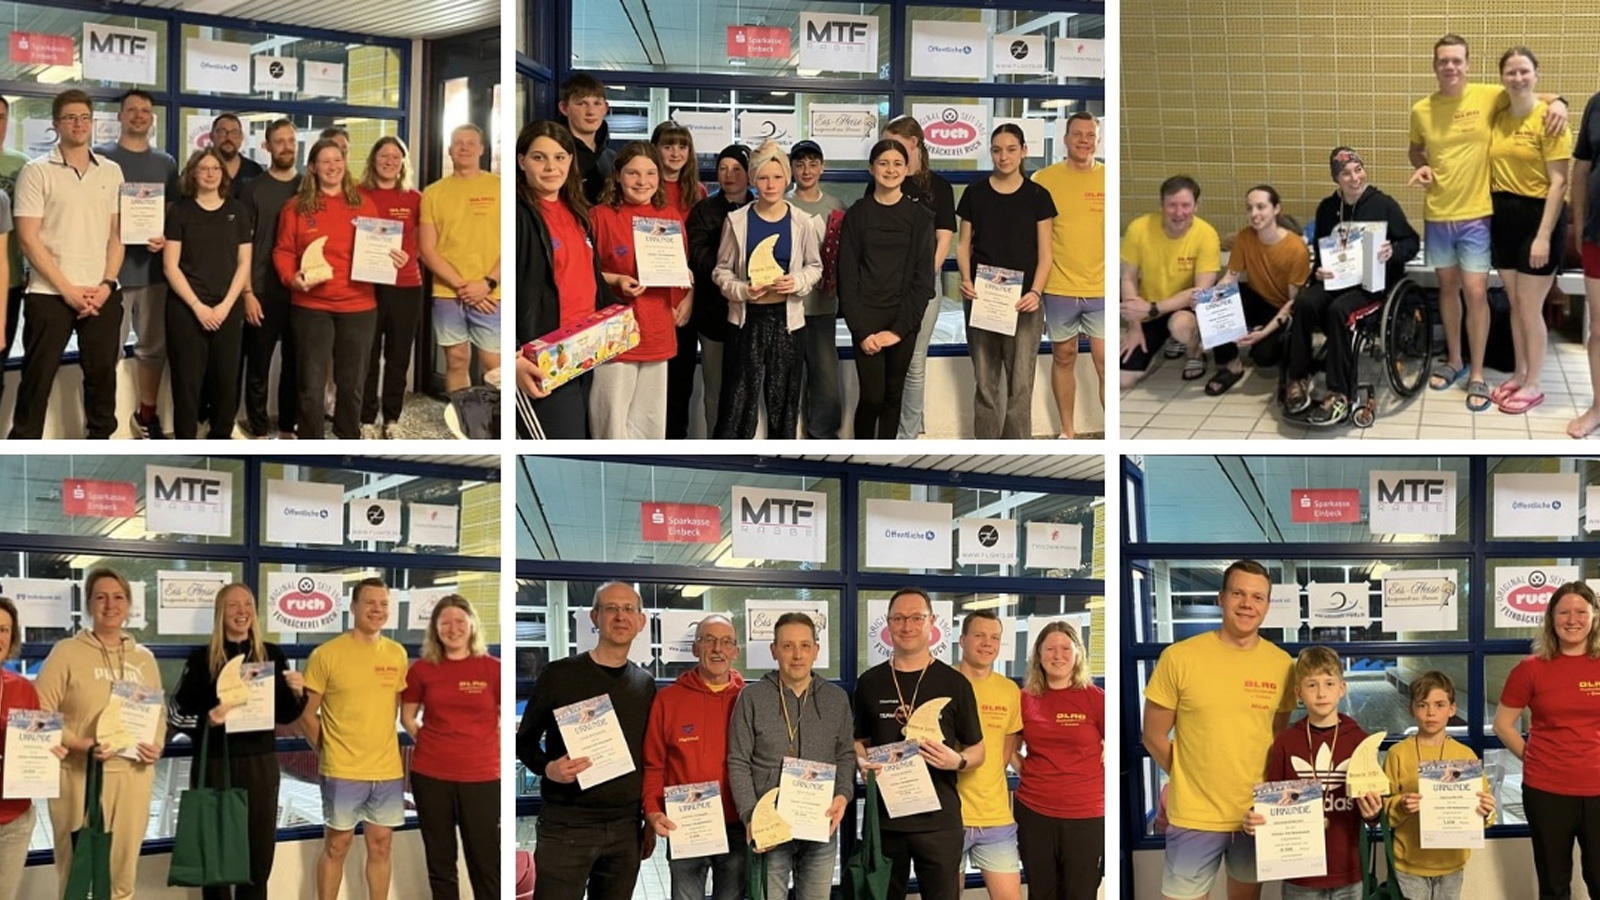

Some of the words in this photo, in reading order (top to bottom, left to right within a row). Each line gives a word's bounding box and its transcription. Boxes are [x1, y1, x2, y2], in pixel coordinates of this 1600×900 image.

[807, 20, 868, 42] MTF
[91, 31, 148, 55] MTF
[748, 36, 782, 45] Sparkasse
[748, 45, 774, 53] Einbeck
[931, 127, 970, 139] ruch
[155, 475, 220, 501] MTF
[1378, 479, 1444, 503] MTF
[1314, 500, 1351, 509] Sparkasse
[741, 496, 814, 525] MTF
[1314, 509, 1342, 518] Einbeck
[668, 516, 711, 526] Sparkasse
[668, 526, 701, 537] Einbeck
[885, 530, 925, 540] Öffentliche
[286, 598, 326, 610] ruch
[1244, 680, 1277, 689] DLRG
[1433, 783, 1471, 791] URKUNDE
[1324, 794, 1354, 812] das
[1270, 805, 1312, 816] URKUNDE
